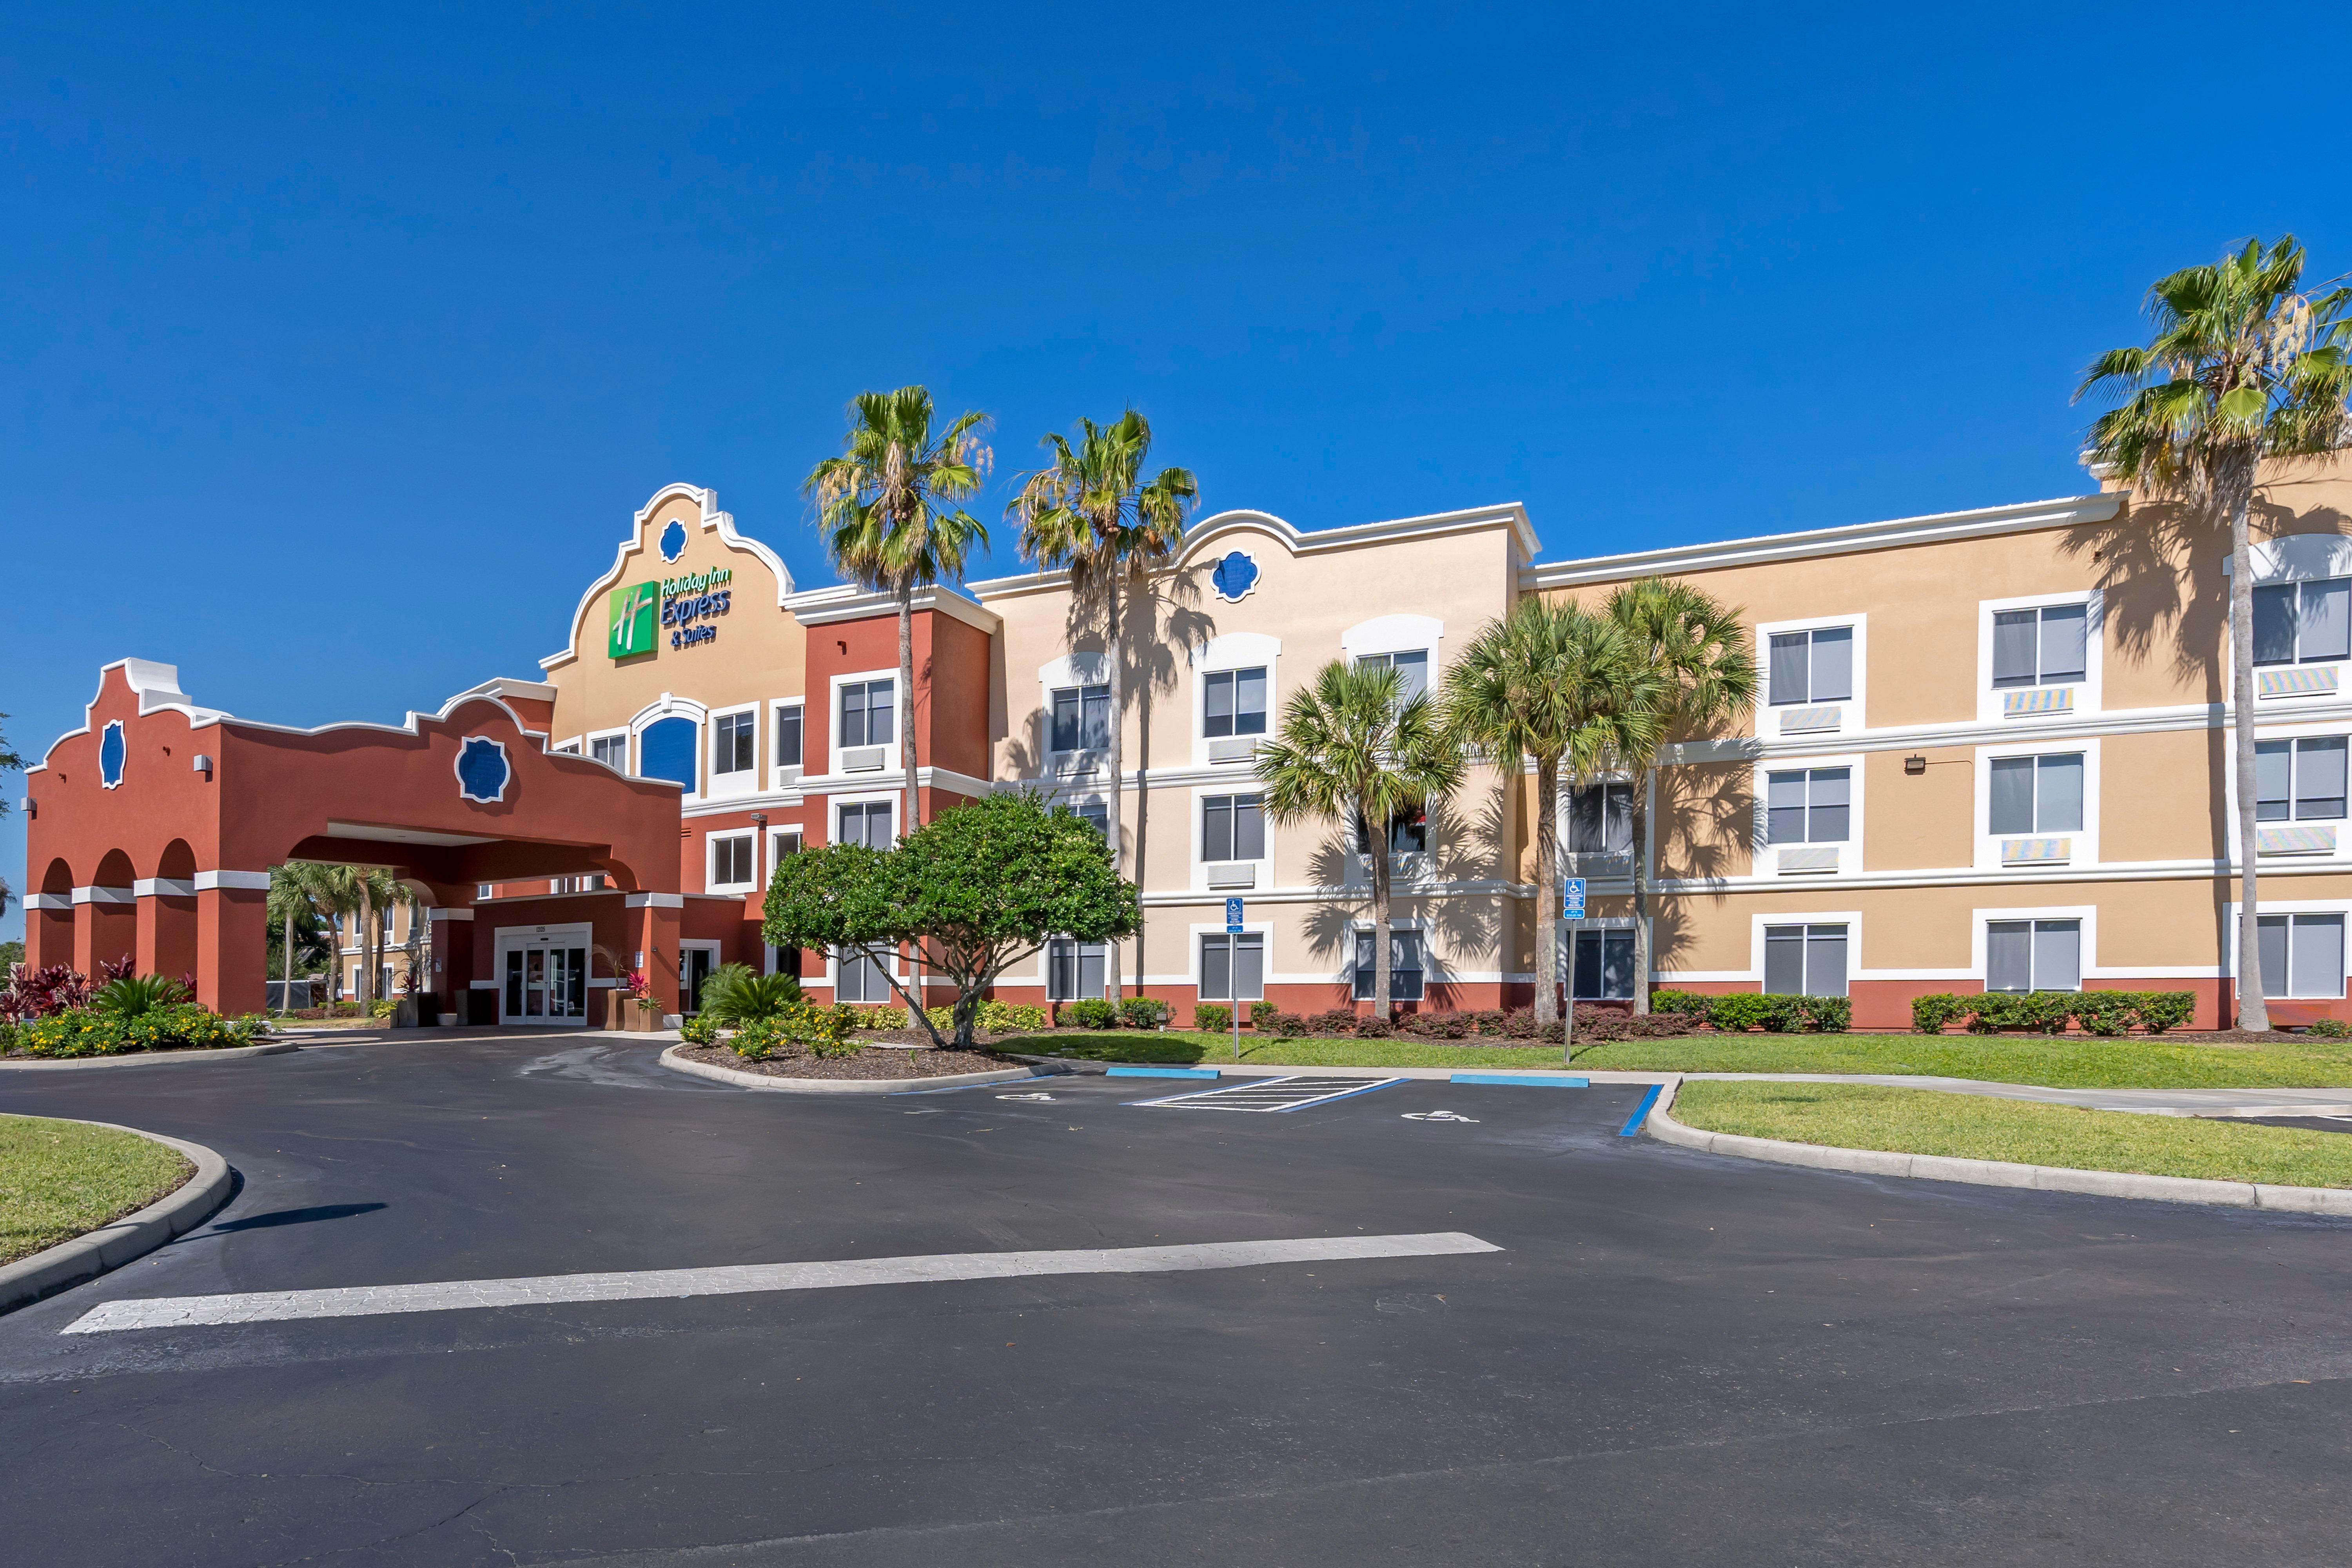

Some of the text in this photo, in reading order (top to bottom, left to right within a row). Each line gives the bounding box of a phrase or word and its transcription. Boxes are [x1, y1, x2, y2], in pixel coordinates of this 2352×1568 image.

[661, 566, 731, 597] Holiday Inn
[661, 590, 730, 627] Express
[670, 625, 715, 646] & Suites
